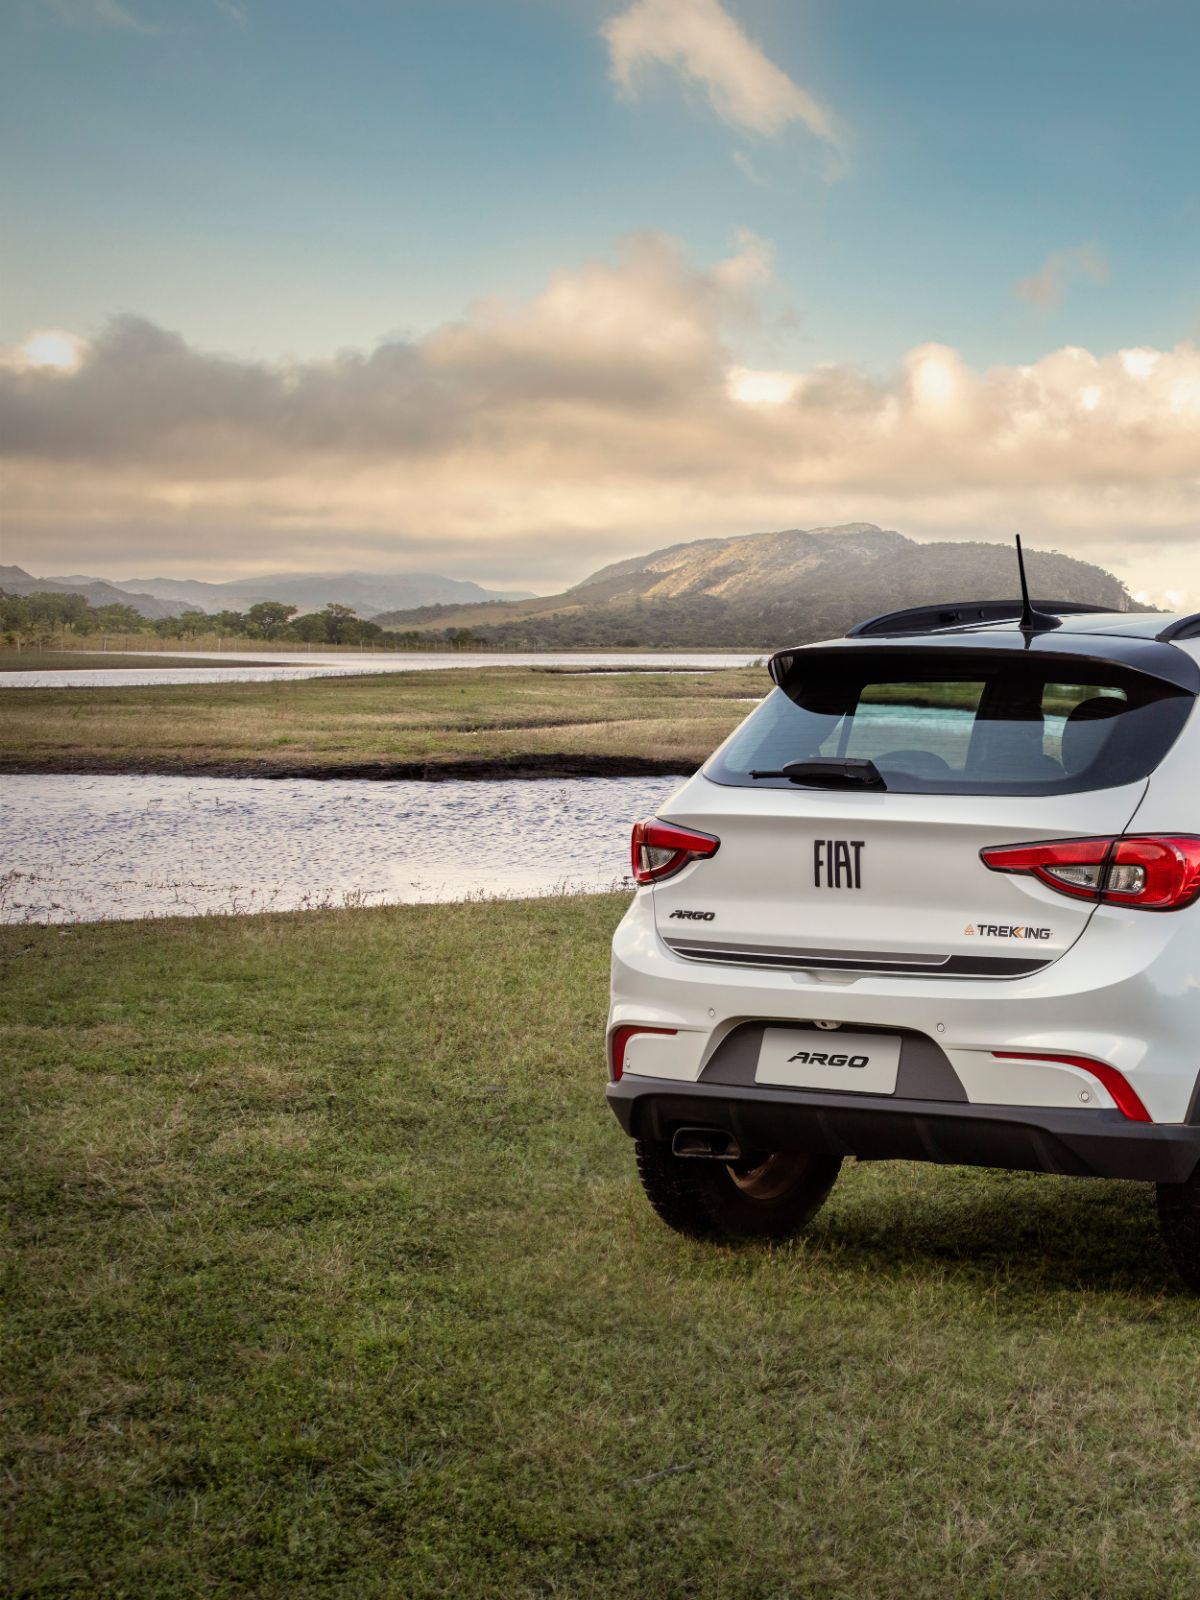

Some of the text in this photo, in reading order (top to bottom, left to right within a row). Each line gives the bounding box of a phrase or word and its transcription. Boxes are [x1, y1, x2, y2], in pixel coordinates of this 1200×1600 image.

[814, 840, 865, 889] FIAT
[669, 910, 716, 921] ARGO
[786, 1051, 870, 1068] ARGO
